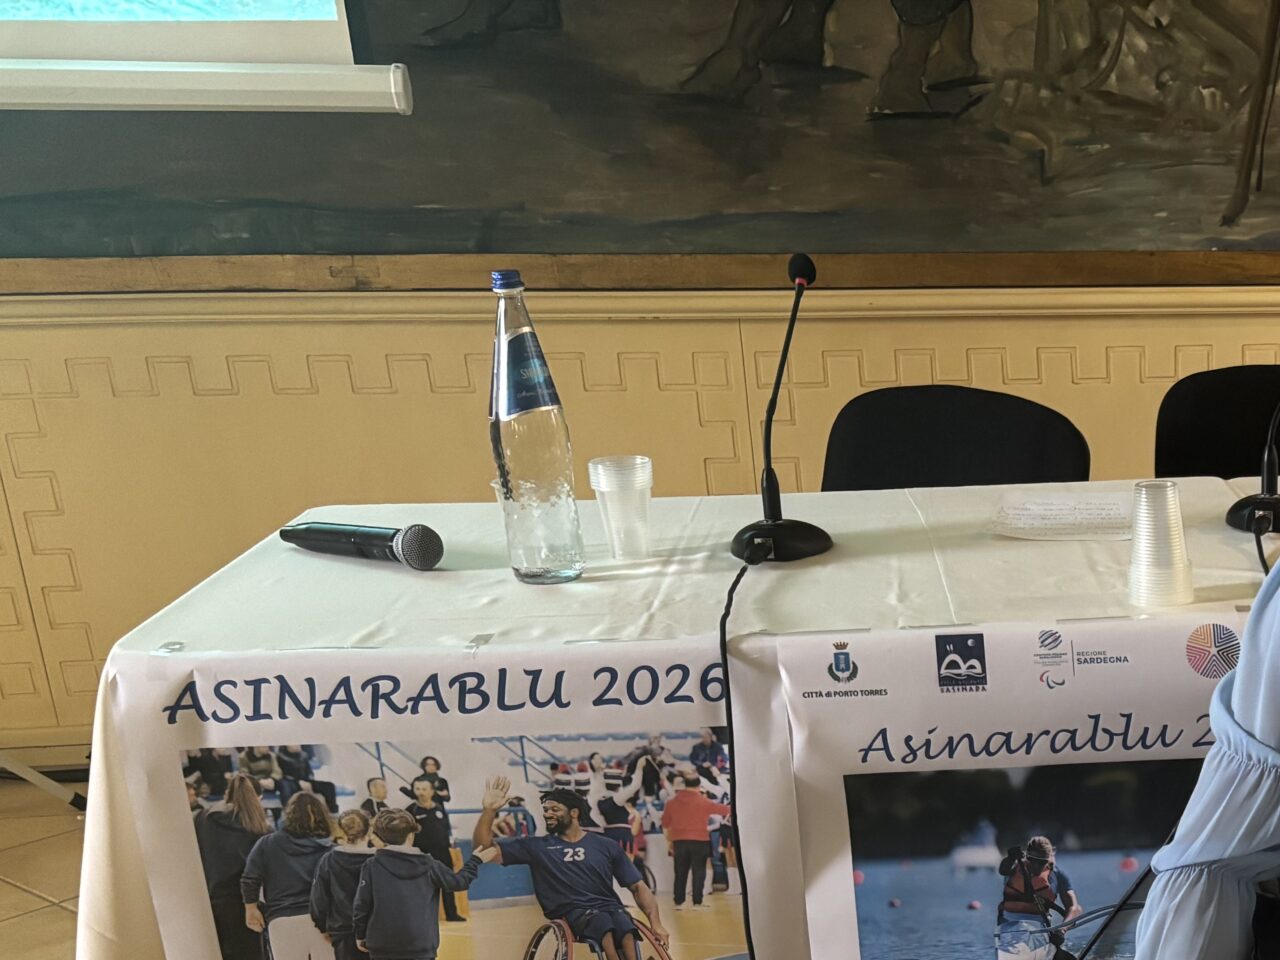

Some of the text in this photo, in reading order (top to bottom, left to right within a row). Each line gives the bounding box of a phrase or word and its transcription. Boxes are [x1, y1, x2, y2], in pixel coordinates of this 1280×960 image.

[1076, 656, 1130, 665] SARDEGNA
[162, 662, 726, 726] ASINARABLU 2026
[825, 690, 833, 698] di
[833, 690, 859, 698] PORTO
[859, 688, 889, 697] TORRES
[859, 712, 1184, 764] Asinarablu
[563, 847, 586, 862] 23
